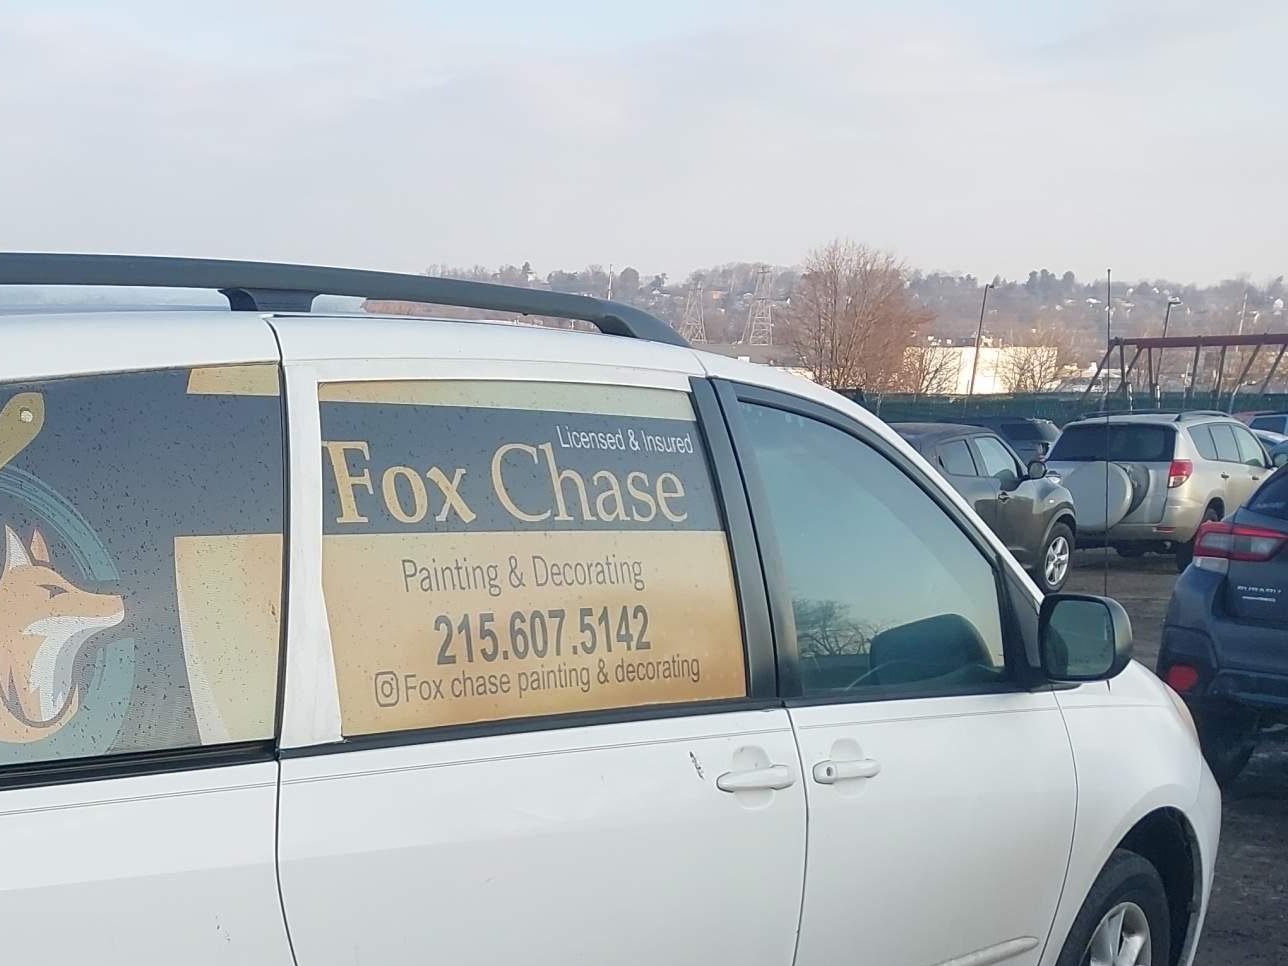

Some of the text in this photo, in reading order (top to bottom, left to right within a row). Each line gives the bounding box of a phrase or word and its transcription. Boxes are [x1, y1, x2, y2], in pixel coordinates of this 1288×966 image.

[556, 425, 694, 454] Licensed & Insured
[322, 440, 688, 524] Fox Chase
[402, 553, 646, 597] Painting & Decorating
[433, 605, 652, 666] 215.607.5142
[404, 654, 701, 703] Fox chase painting & decorating
